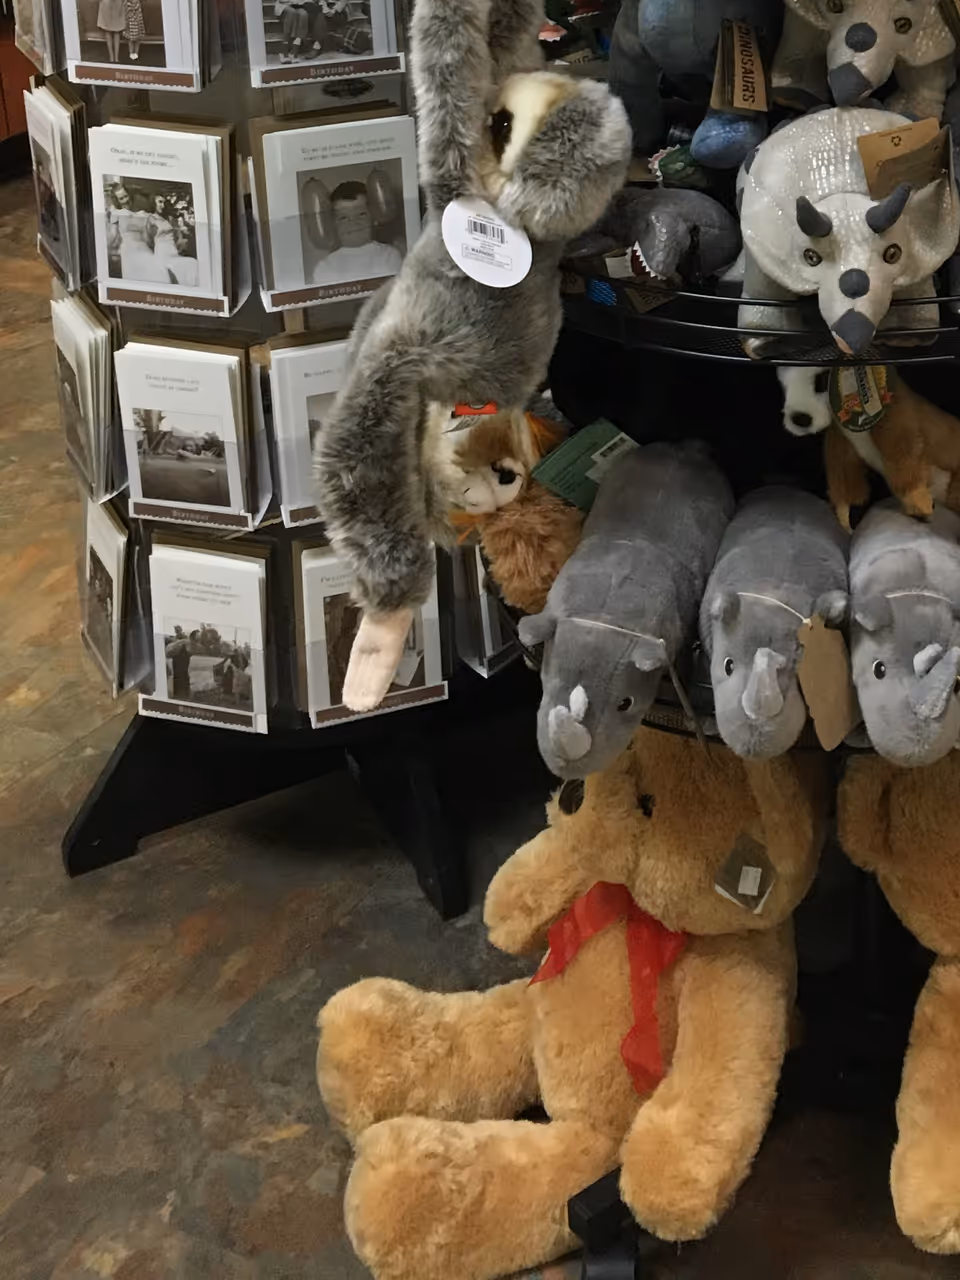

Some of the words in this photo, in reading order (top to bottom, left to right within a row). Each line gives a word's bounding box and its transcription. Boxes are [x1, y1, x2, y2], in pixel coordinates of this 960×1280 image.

[741, 22, 757, 104] DINOSAURS
[115, 71, 154, 82] BIRTHDAY
[309, 65, 355, 77] BIRTHDAY
[318, 284, 363, 298] BIRTHDAY
[146, 293, 185, 306] BIRTHDAY
